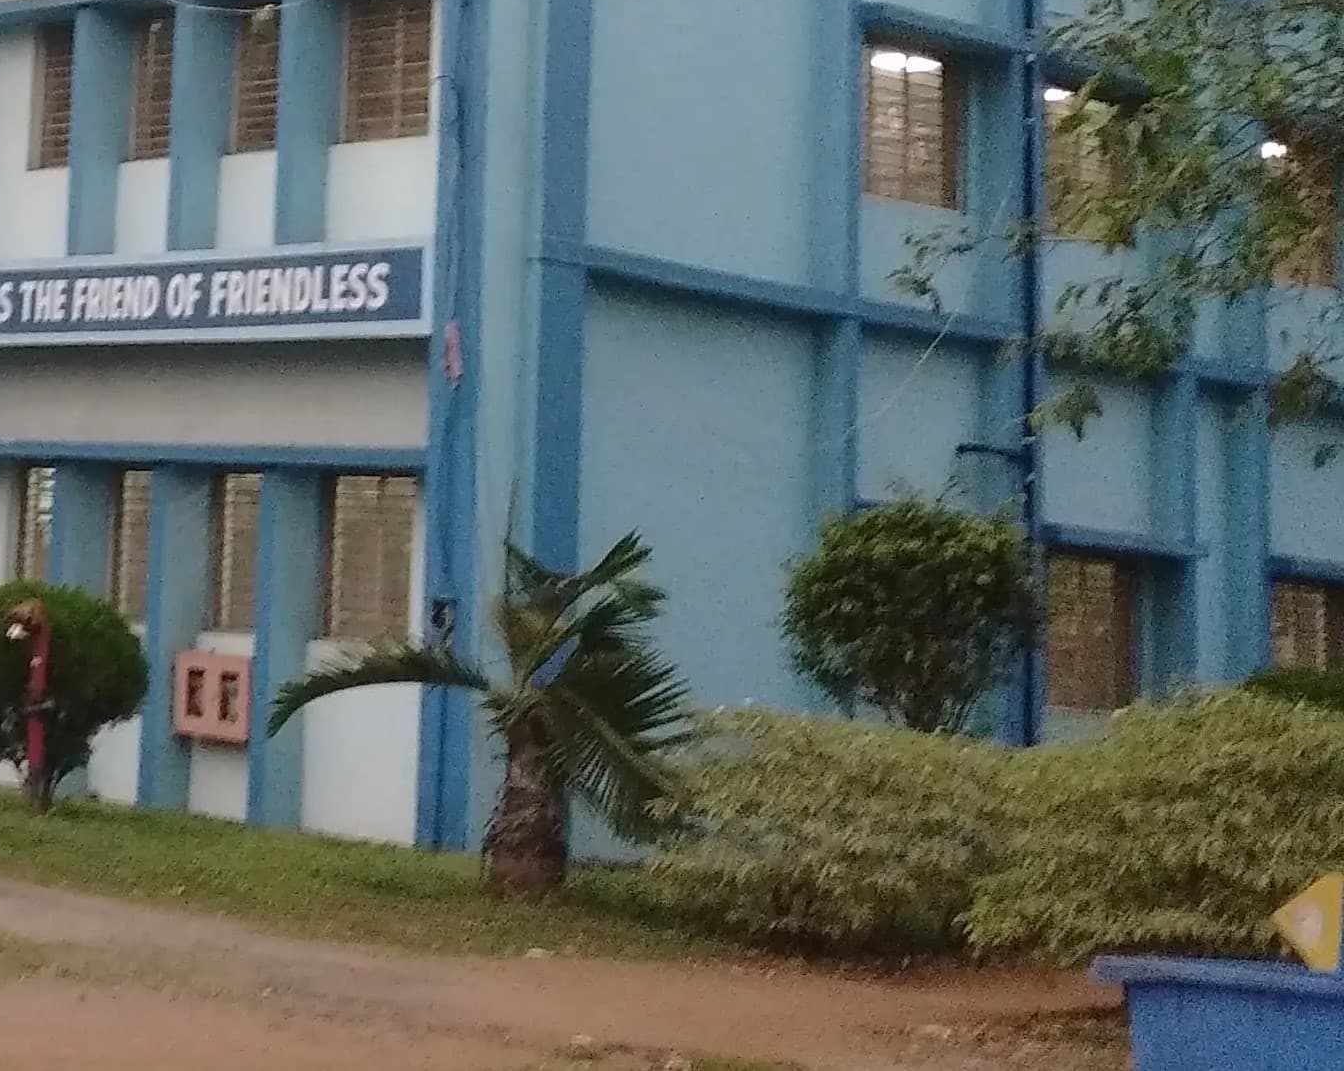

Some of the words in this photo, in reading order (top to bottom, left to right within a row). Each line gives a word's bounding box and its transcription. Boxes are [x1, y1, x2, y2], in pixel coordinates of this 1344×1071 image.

[19, 278, 69, 323] THE
[71, 274, 160, 322] FRIEND
[165, 271, 204, 319] OF
[210, 261, 391, 318] FRIENDLESS
